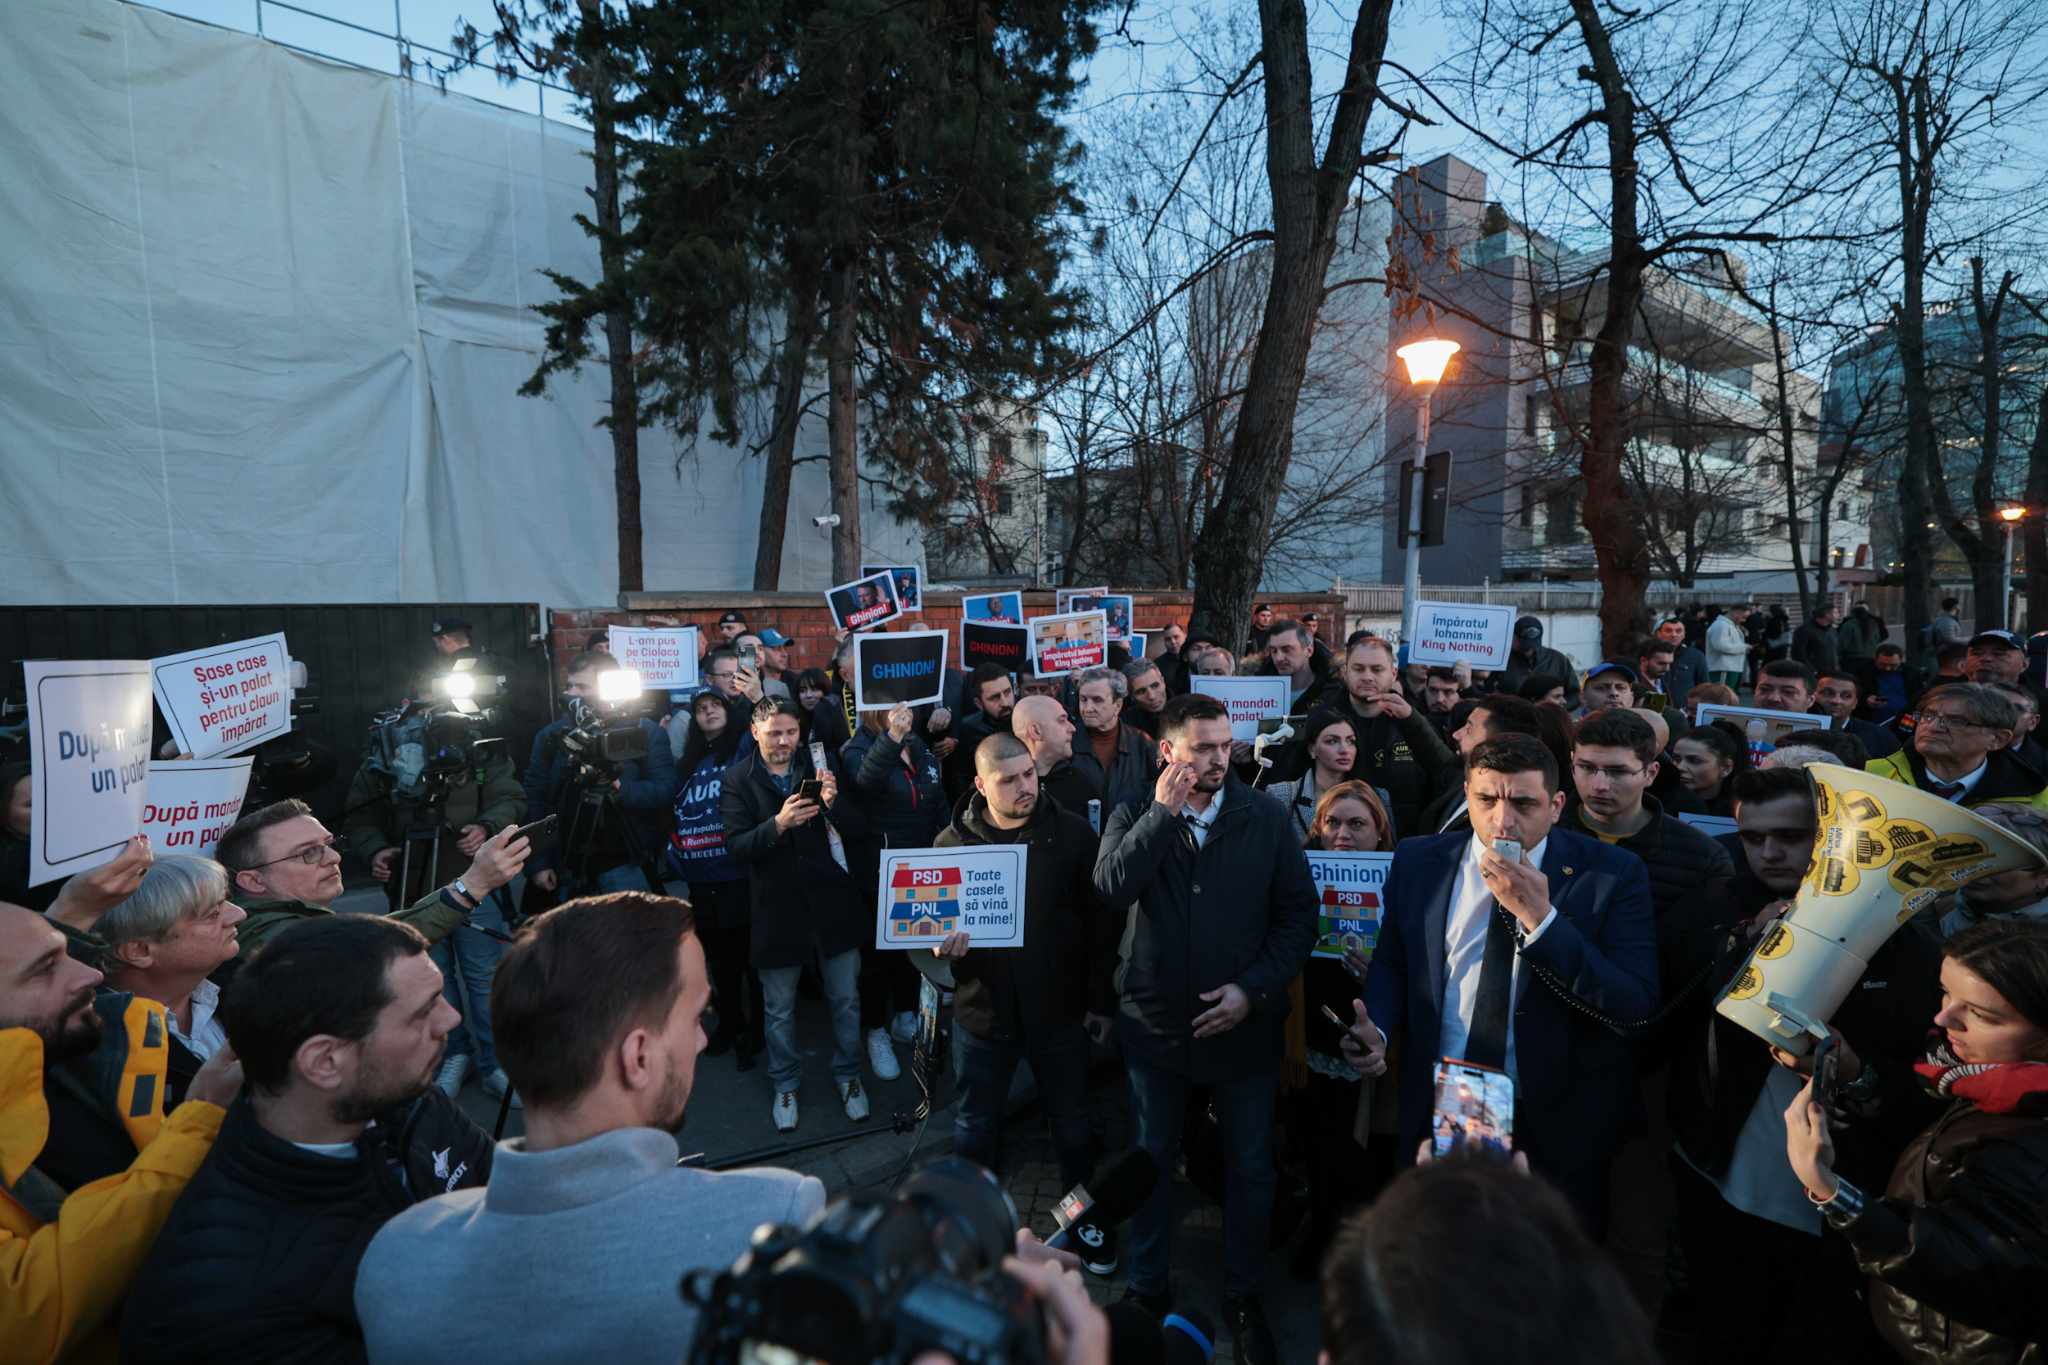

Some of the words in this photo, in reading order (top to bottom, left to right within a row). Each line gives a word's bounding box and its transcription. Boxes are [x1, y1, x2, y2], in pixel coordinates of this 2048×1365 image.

[850, 604, 888, 625] Ghinion!
[1432, 612, 1489, 629] Împăratul
[1435, 628, 1483, 641] Iohannis
[641, 647, 679, 657] Ciolacu
[970, 641, 1019, 657] GHINION!
[1422, 639, 1446, 652] King
[1448, 640, 1493, 656] Nothing
[193, 663, 234, 687] Șase
[236, 655, 267, 672] case
[872, 659, 935, 679] GHINION!
[200, 683, 239, 709] și-un
[240, 671, 272, 697] palat
[200, 702, 246, 732] pentru
[250, 691, 279, 711] claun
[1232, 711, 1264, 723] palat!
[221, 713, 266, 742] împărat
[91, 768, 117, 793] un
[682, 780, 721, 807] AUR
[143, 800, 199, 827] După
[166, 830, 194, 847] un
[912, 870, 943, 885] PSD
[967, 870, 1001, 882] Toate
[966, 883, 1005, 896] casele
[965, 900, 978, 911] să
[982, 898, 1009, 910] vină
[1338, 893, 1362, 905] PSD
[912, 902, 941, 916] PNL
[964, 914, 975, 926] la
[979, 912, 1013, 925] mine!
[1339, 919, 1364, 932] PNL
